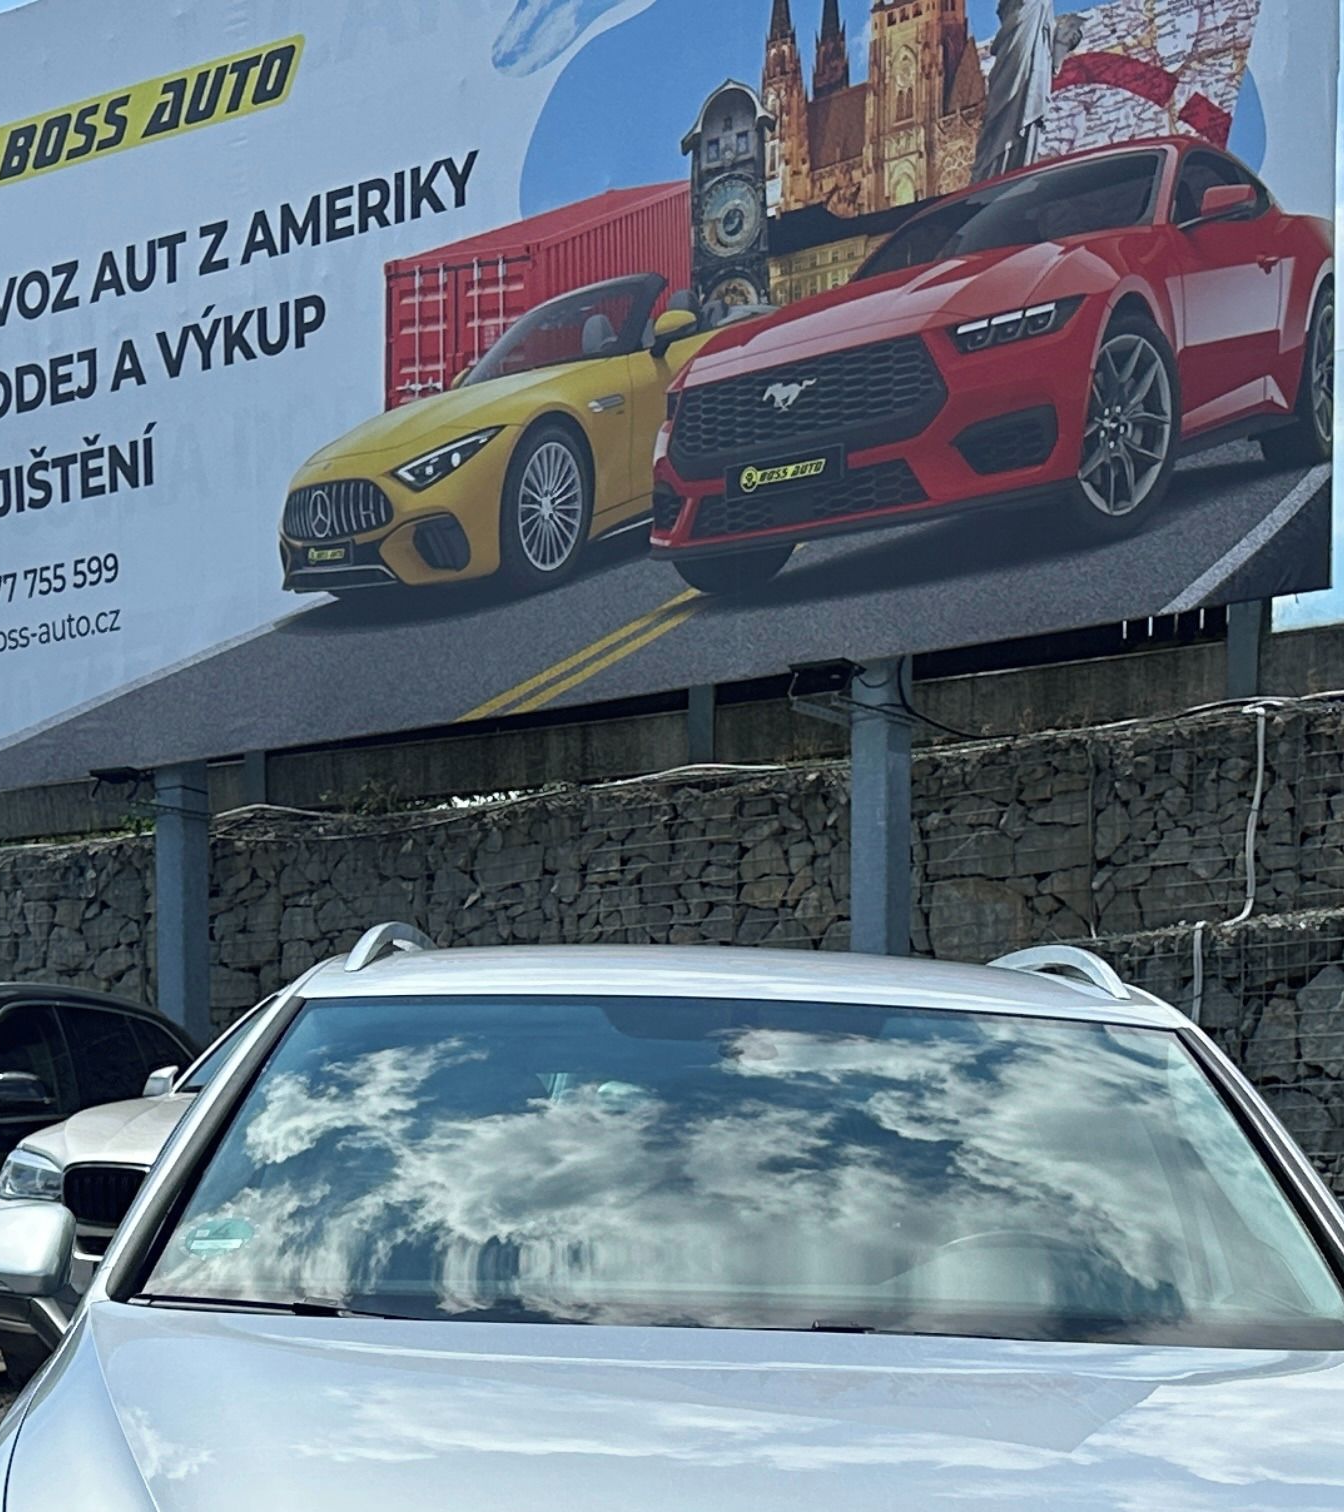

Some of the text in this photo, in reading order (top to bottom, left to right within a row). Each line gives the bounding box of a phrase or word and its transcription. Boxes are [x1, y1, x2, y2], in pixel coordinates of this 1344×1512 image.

[141, 43, 297, 138] AUTO
[90, 230, 187, 303] AUT
[198, 219, 230, 276] Z
[240, 149, 480, 265] AMERIKY
[110, 338, 146, 393] A
[158, 293, 327, 379] VÝKUP
[23, 561, 67, 598] 755
[73, 552, 120, 588] 599
